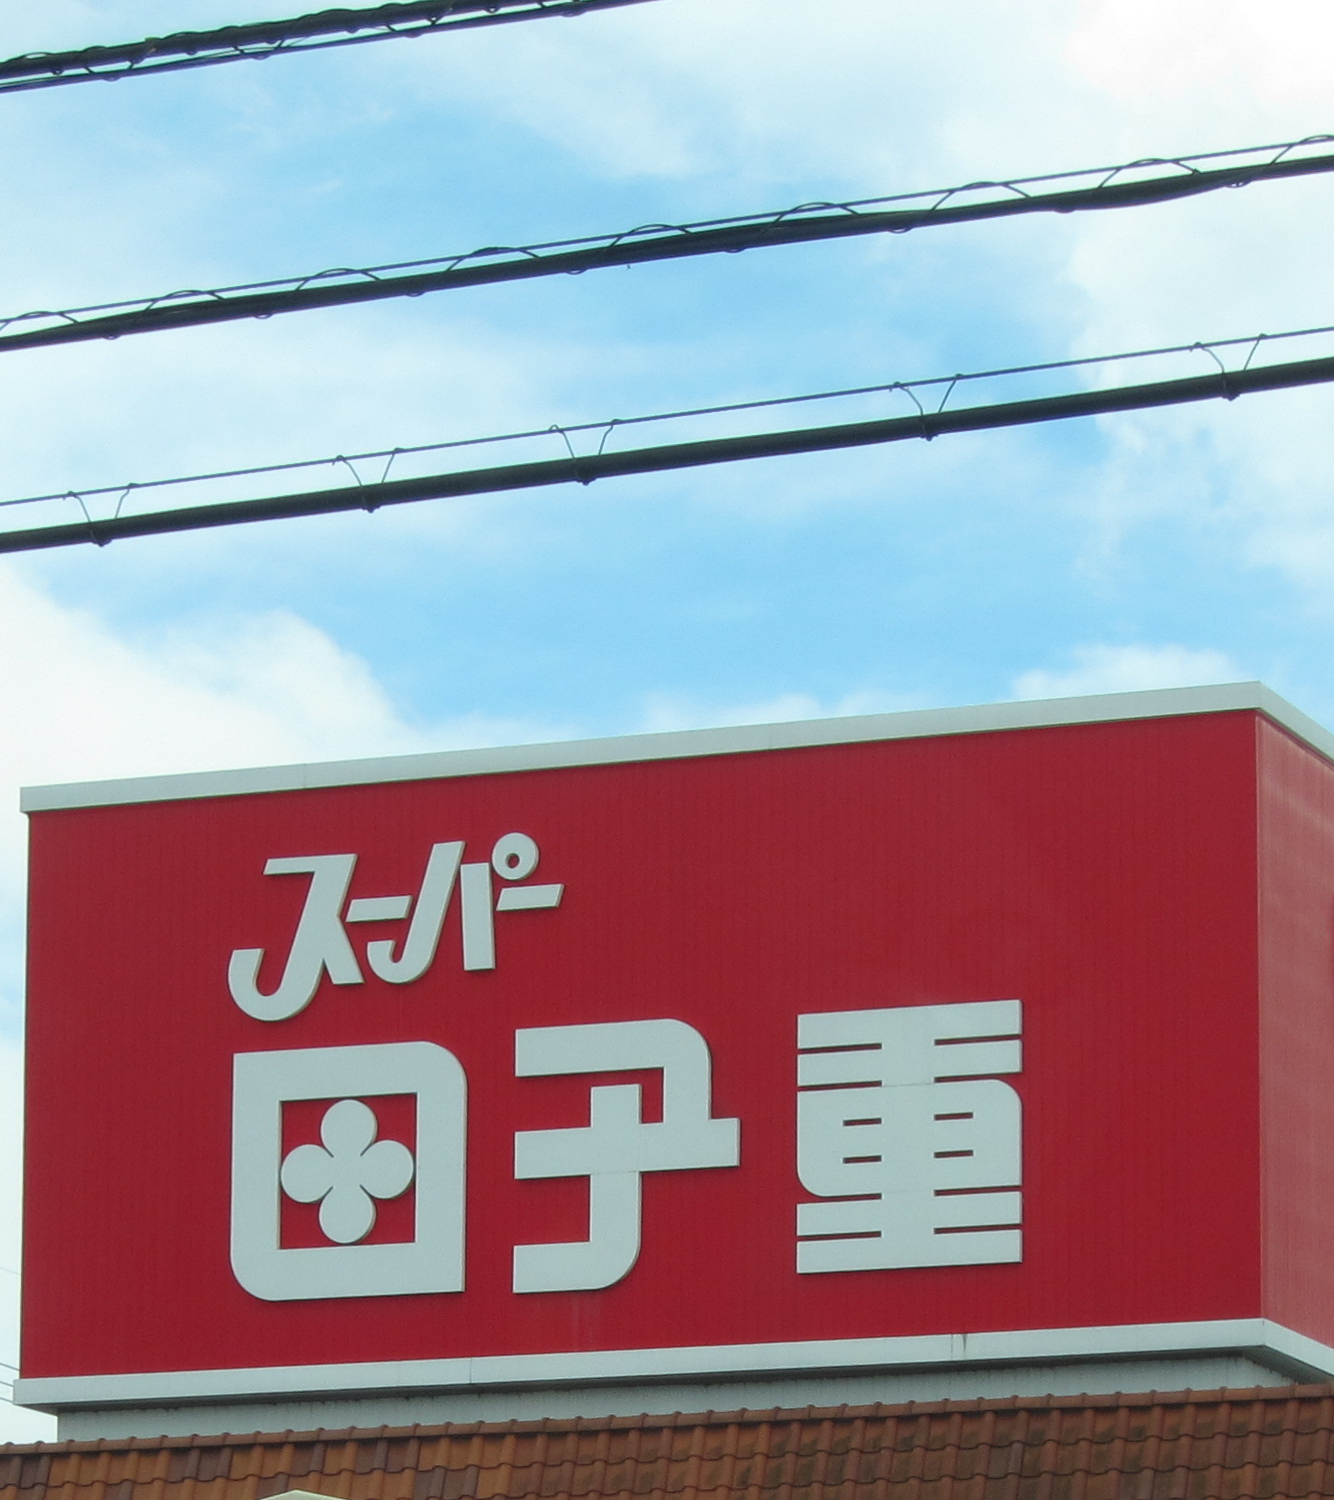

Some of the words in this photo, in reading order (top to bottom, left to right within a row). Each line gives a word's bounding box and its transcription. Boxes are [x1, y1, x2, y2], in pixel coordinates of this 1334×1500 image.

[228, 832, 565, 1021] スーパー
[230, 999, 1023, 1301] 田子重
